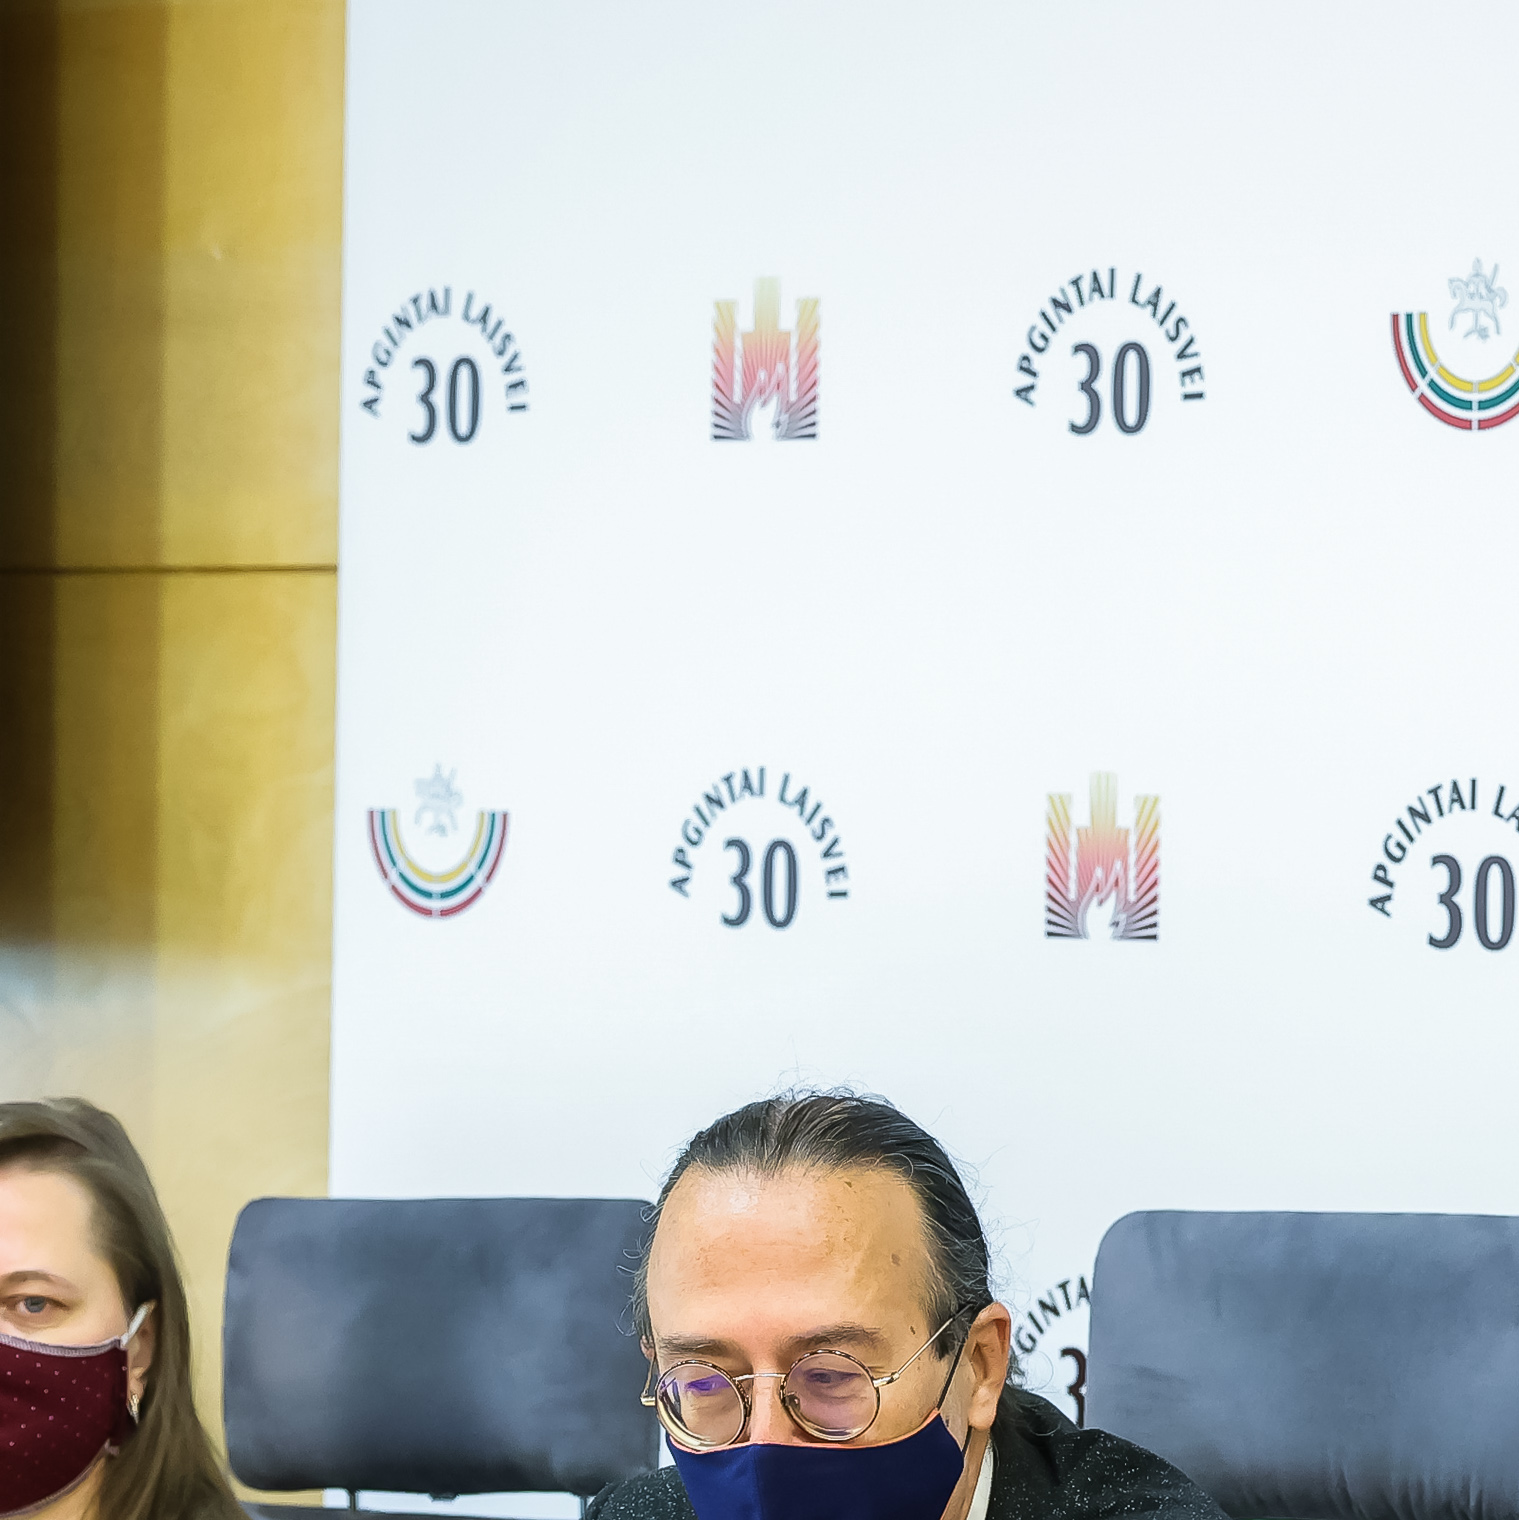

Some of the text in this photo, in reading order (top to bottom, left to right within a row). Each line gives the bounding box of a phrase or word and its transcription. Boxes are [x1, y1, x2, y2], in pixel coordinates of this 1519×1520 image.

[359, 286, 529, 417] APGINTAI LAISVEI
[1012, 266, 1206, 408] APGINTAI LAISVEI
[407, 355, 482, 446] 30
[1067, 340, 1152, 437] 30
[668, 765, 850, 900] APGINTAI LAISVEI
[1367, 777, 1478, 918] APGINTAI
[720, 836, 800, 930] 30
[1426, 852, 1517, 953] 30
[1013, 1275, 1092, 1355] GINTA
[1059, 1346, 1088, 1429] 3
